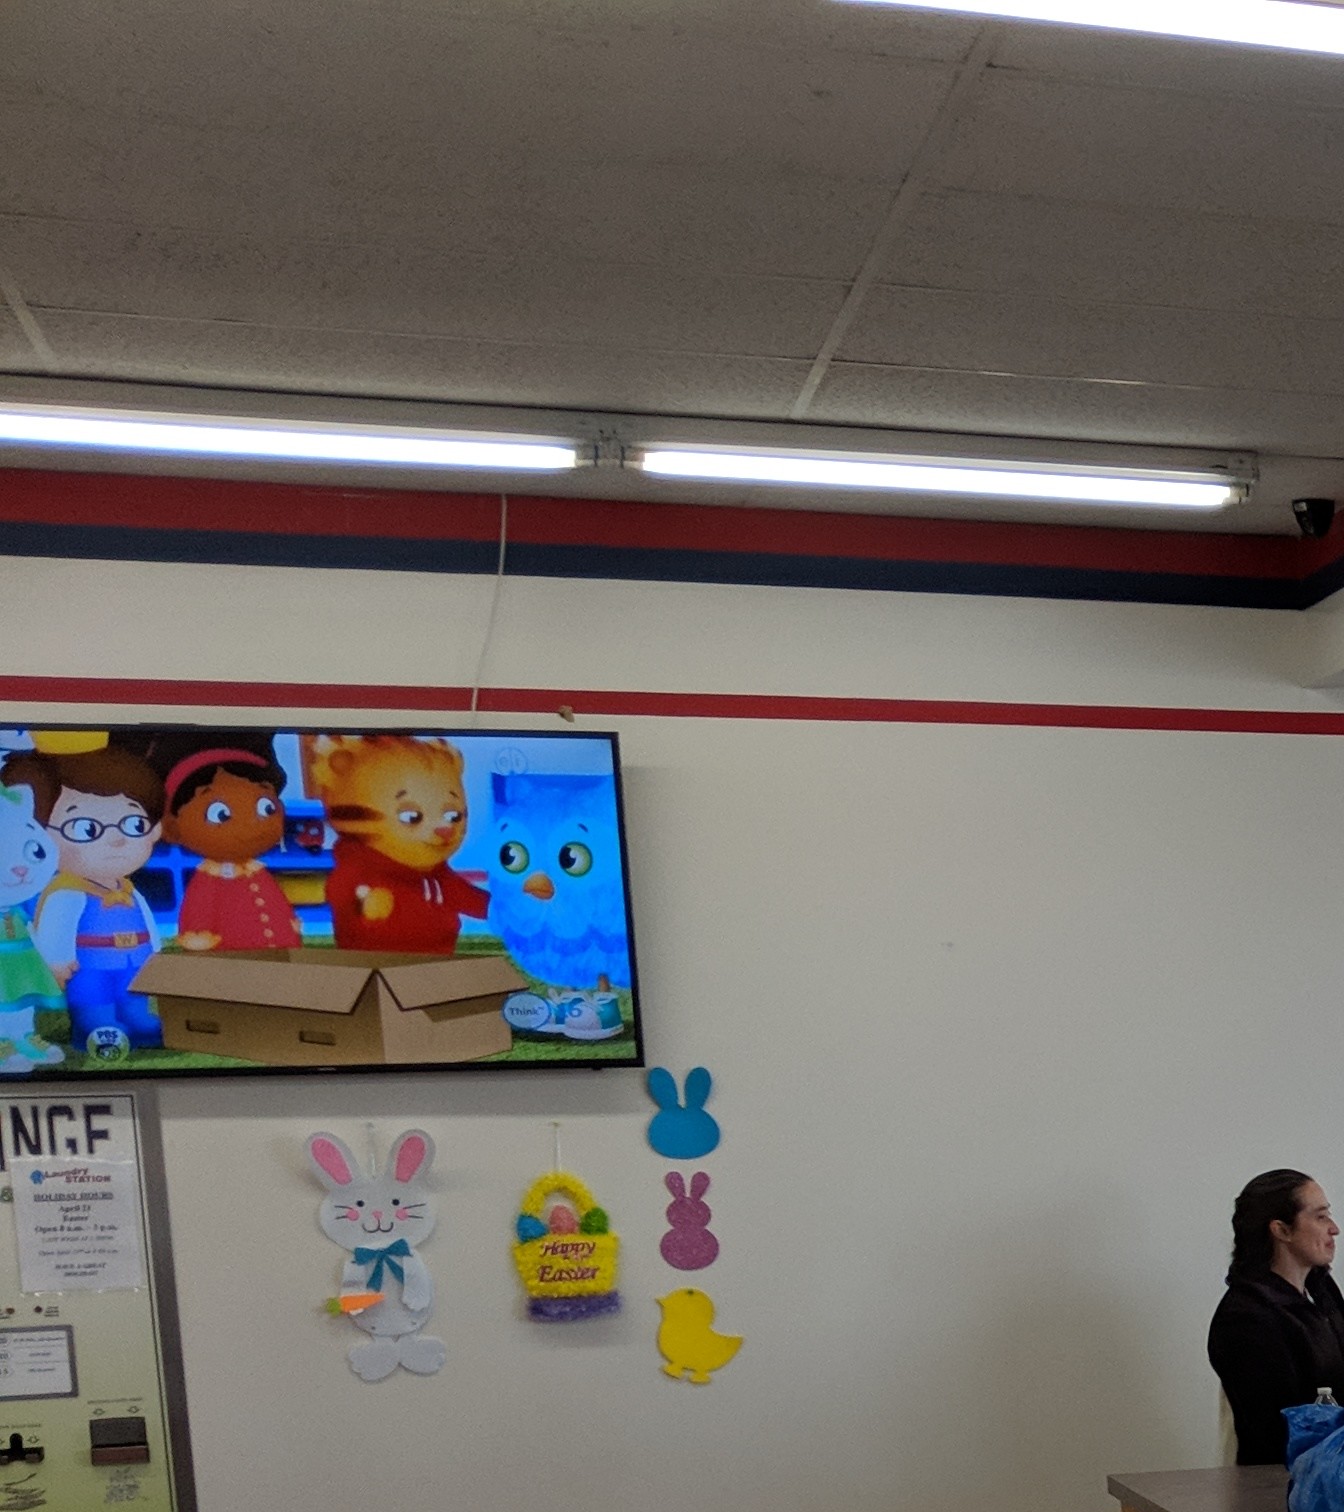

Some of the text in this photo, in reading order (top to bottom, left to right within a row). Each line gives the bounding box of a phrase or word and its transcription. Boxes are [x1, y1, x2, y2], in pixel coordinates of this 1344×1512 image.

[509, 1006, 539, 1017] Think
[65, 1175, 111, 1184] STATION
[540, 1241, 596, 1261] Happy
[539, 1265, 600, 1282] Easter
